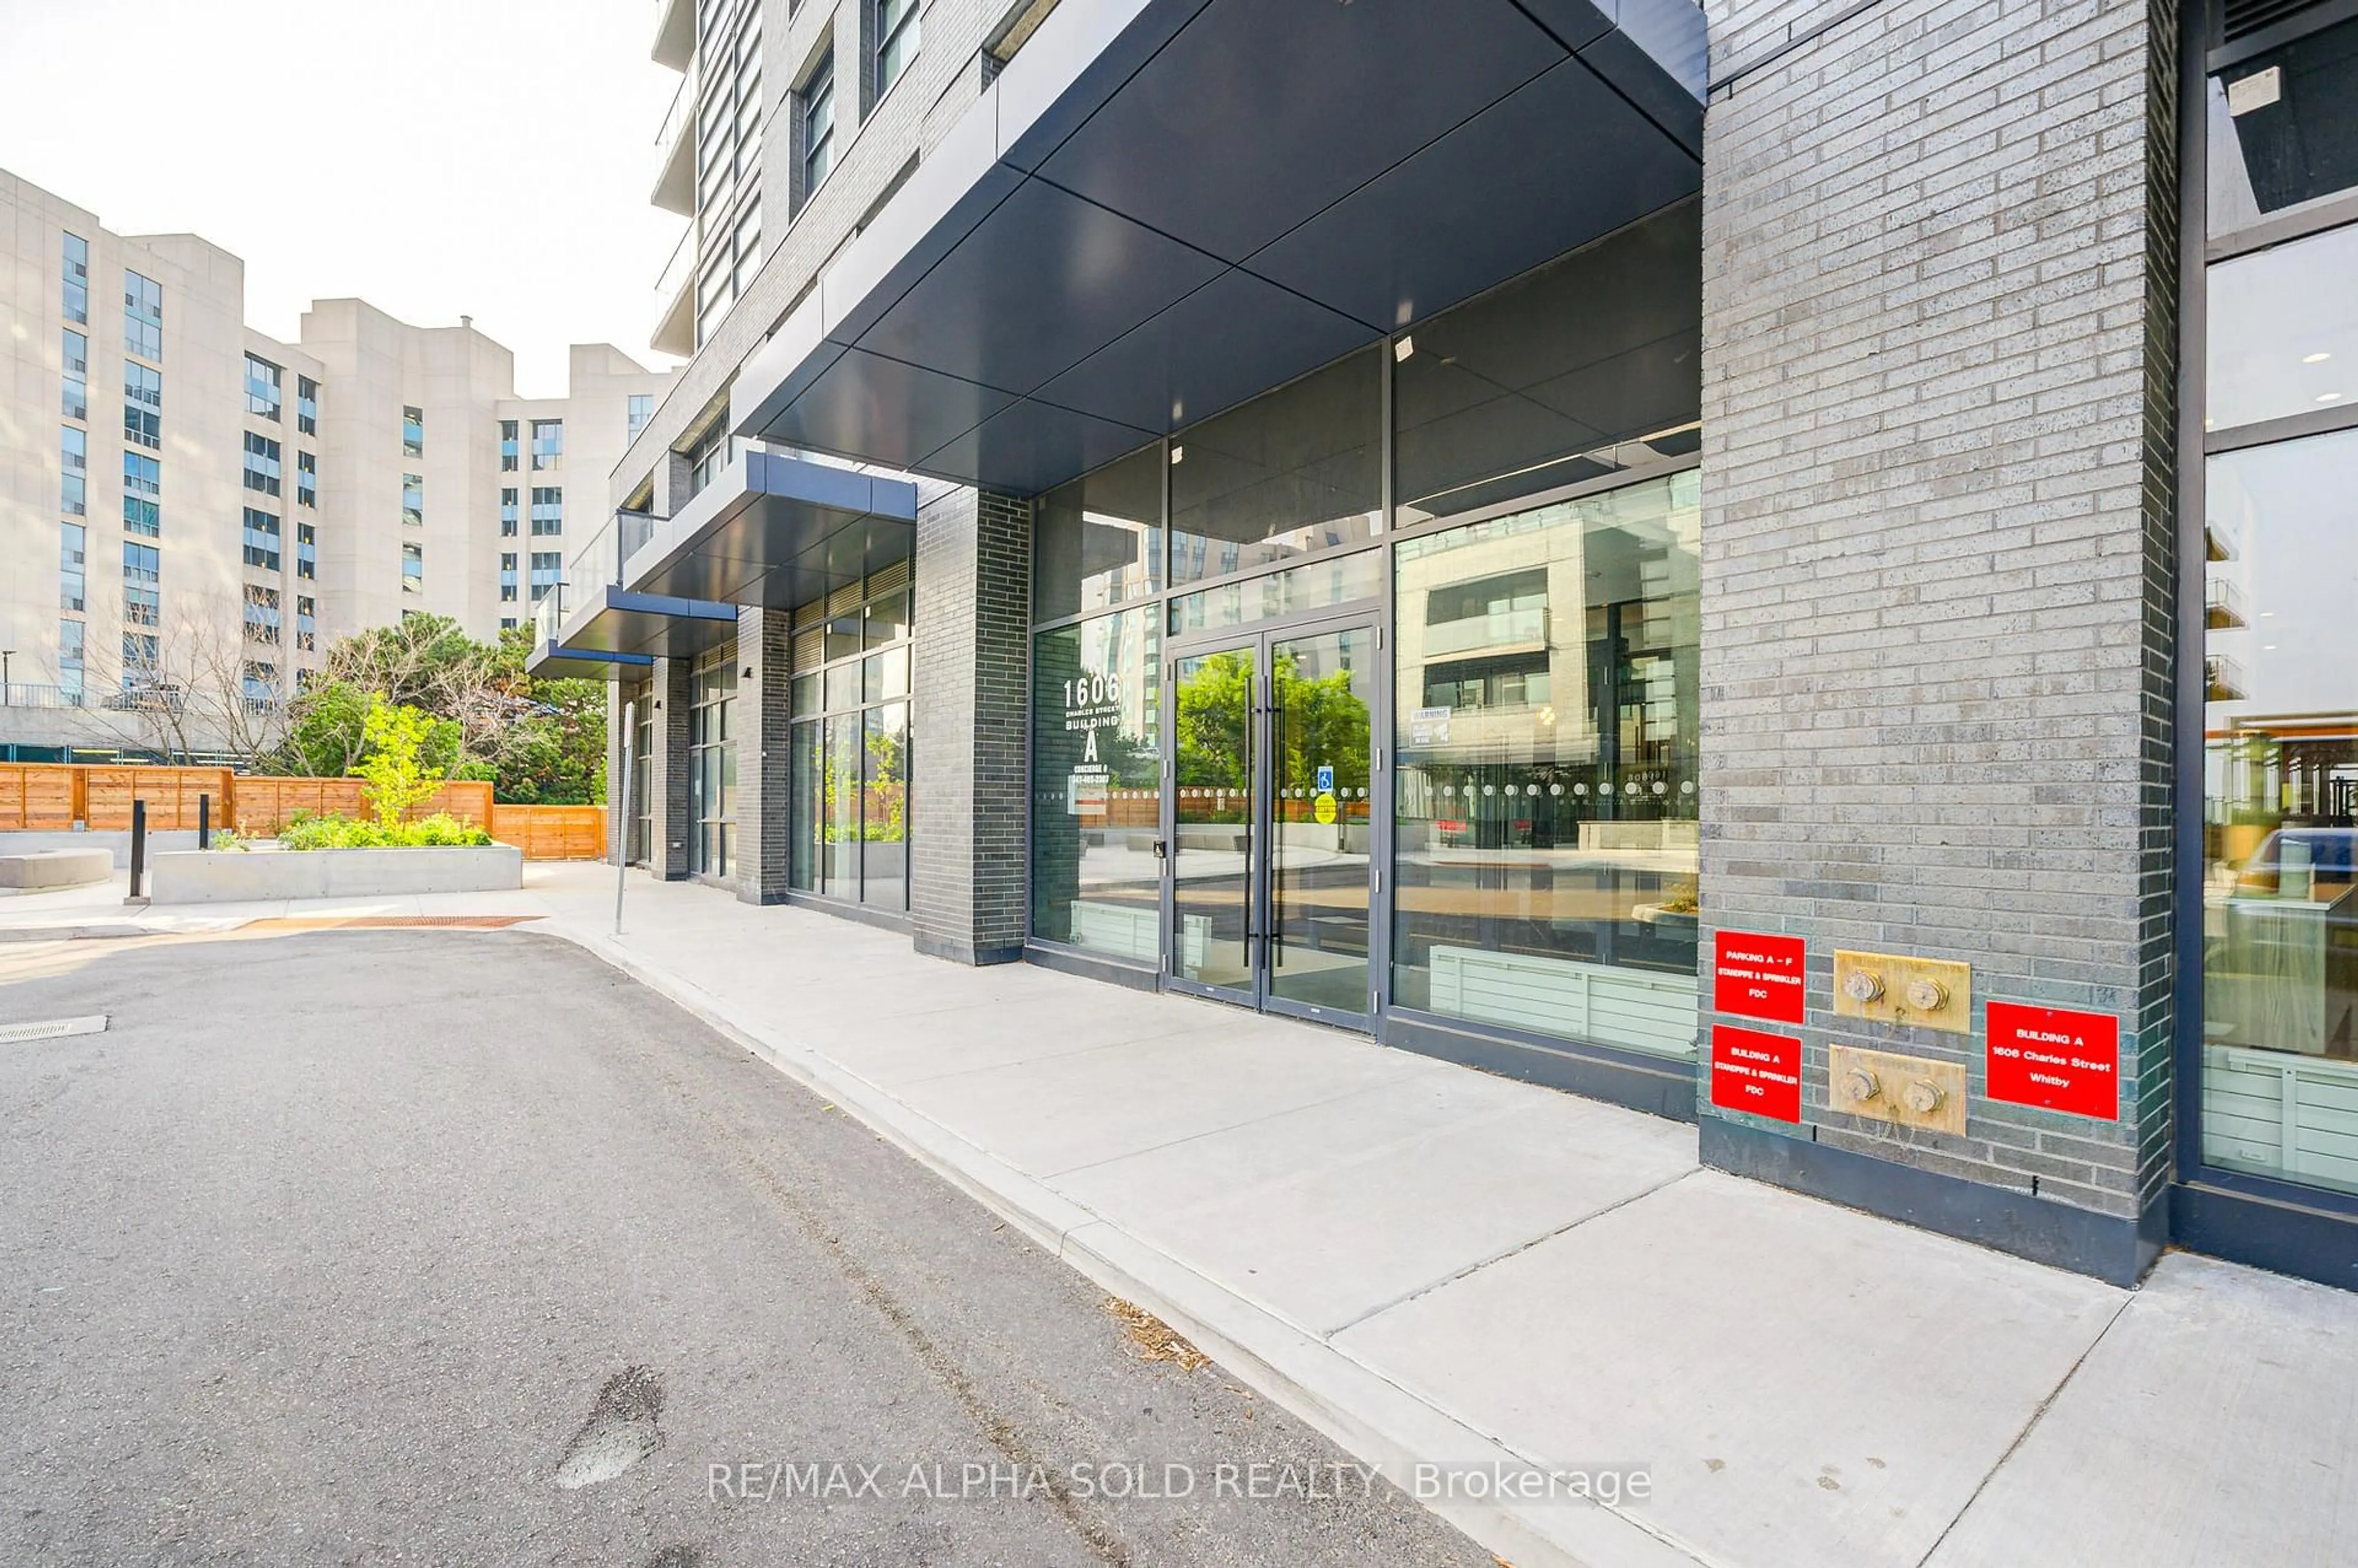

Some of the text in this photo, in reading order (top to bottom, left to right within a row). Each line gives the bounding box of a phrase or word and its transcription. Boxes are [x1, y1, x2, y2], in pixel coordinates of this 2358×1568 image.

[1064, 673, 1118, 708] 1606
[1066, 716, 1118, 731] BUILDING
[1084, 730, 1098, 762] A
[1726, 950, 1764, 963] PARKING
[1766, 955, 1774, 964] A
[1785, 958, 1792, 966] F
[1762, 972, 1801, 985] SPRINKLER
[1749, 988, 1767, 999] FDC
[2017, 1028, 2084, 1047] BUILDING A
[1730, 1047, 1780, 1064] BUILDING A
[1992, 1046, 2111, 1072] 1606 Charles Street
[1759, 1070, 1797, 1085] SPRINKLER
[2029, 1072, 2070, 1089] Whitby
[1745, 1084, 1764, 1096] FDC
